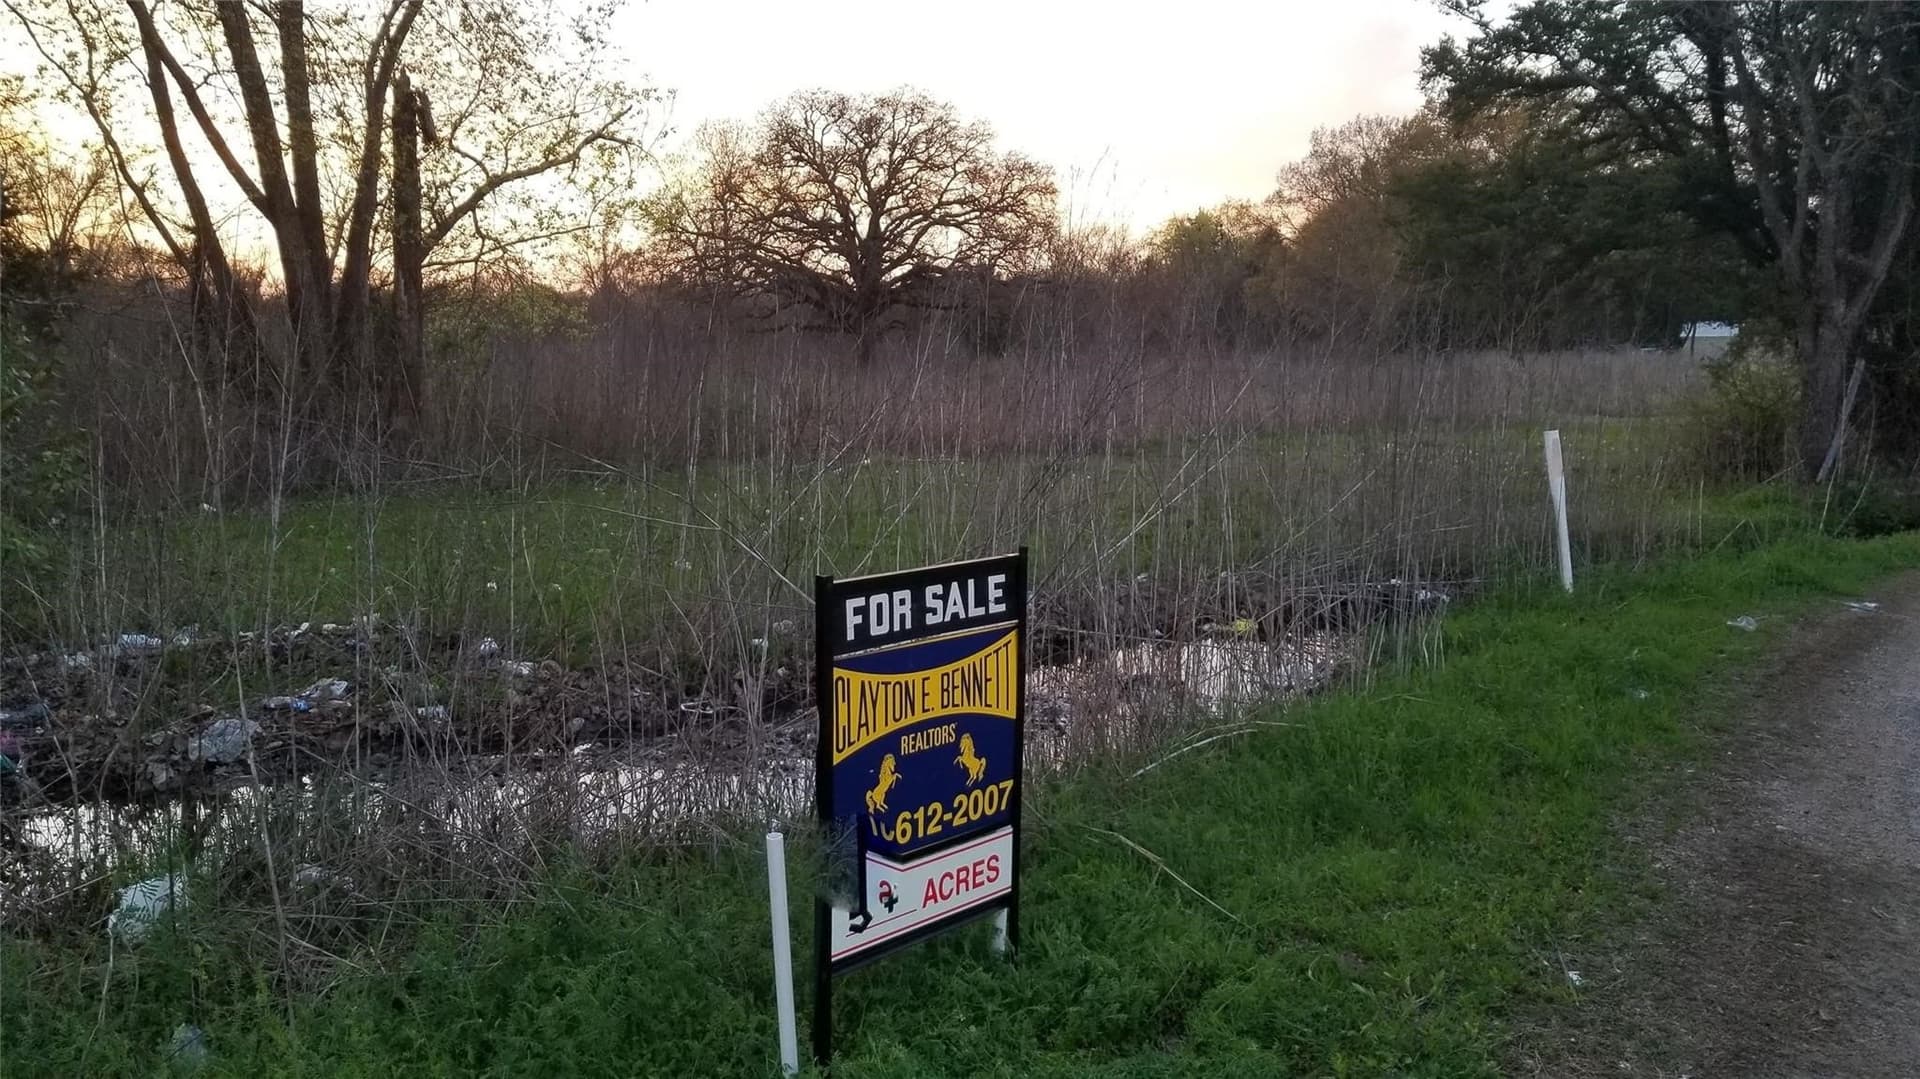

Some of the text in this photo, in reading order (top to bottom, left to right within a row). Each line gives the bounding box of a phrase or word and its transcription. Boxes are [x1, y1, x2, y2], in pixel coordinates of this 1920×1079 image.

[846, 574, 1007, 641] FOR SALE
[835, 639, 1012, 754] CLAYTON E. BENNETT
[901, 723, 957, 755] REALTORS
[922, 854, 1000, 908] ACRES
